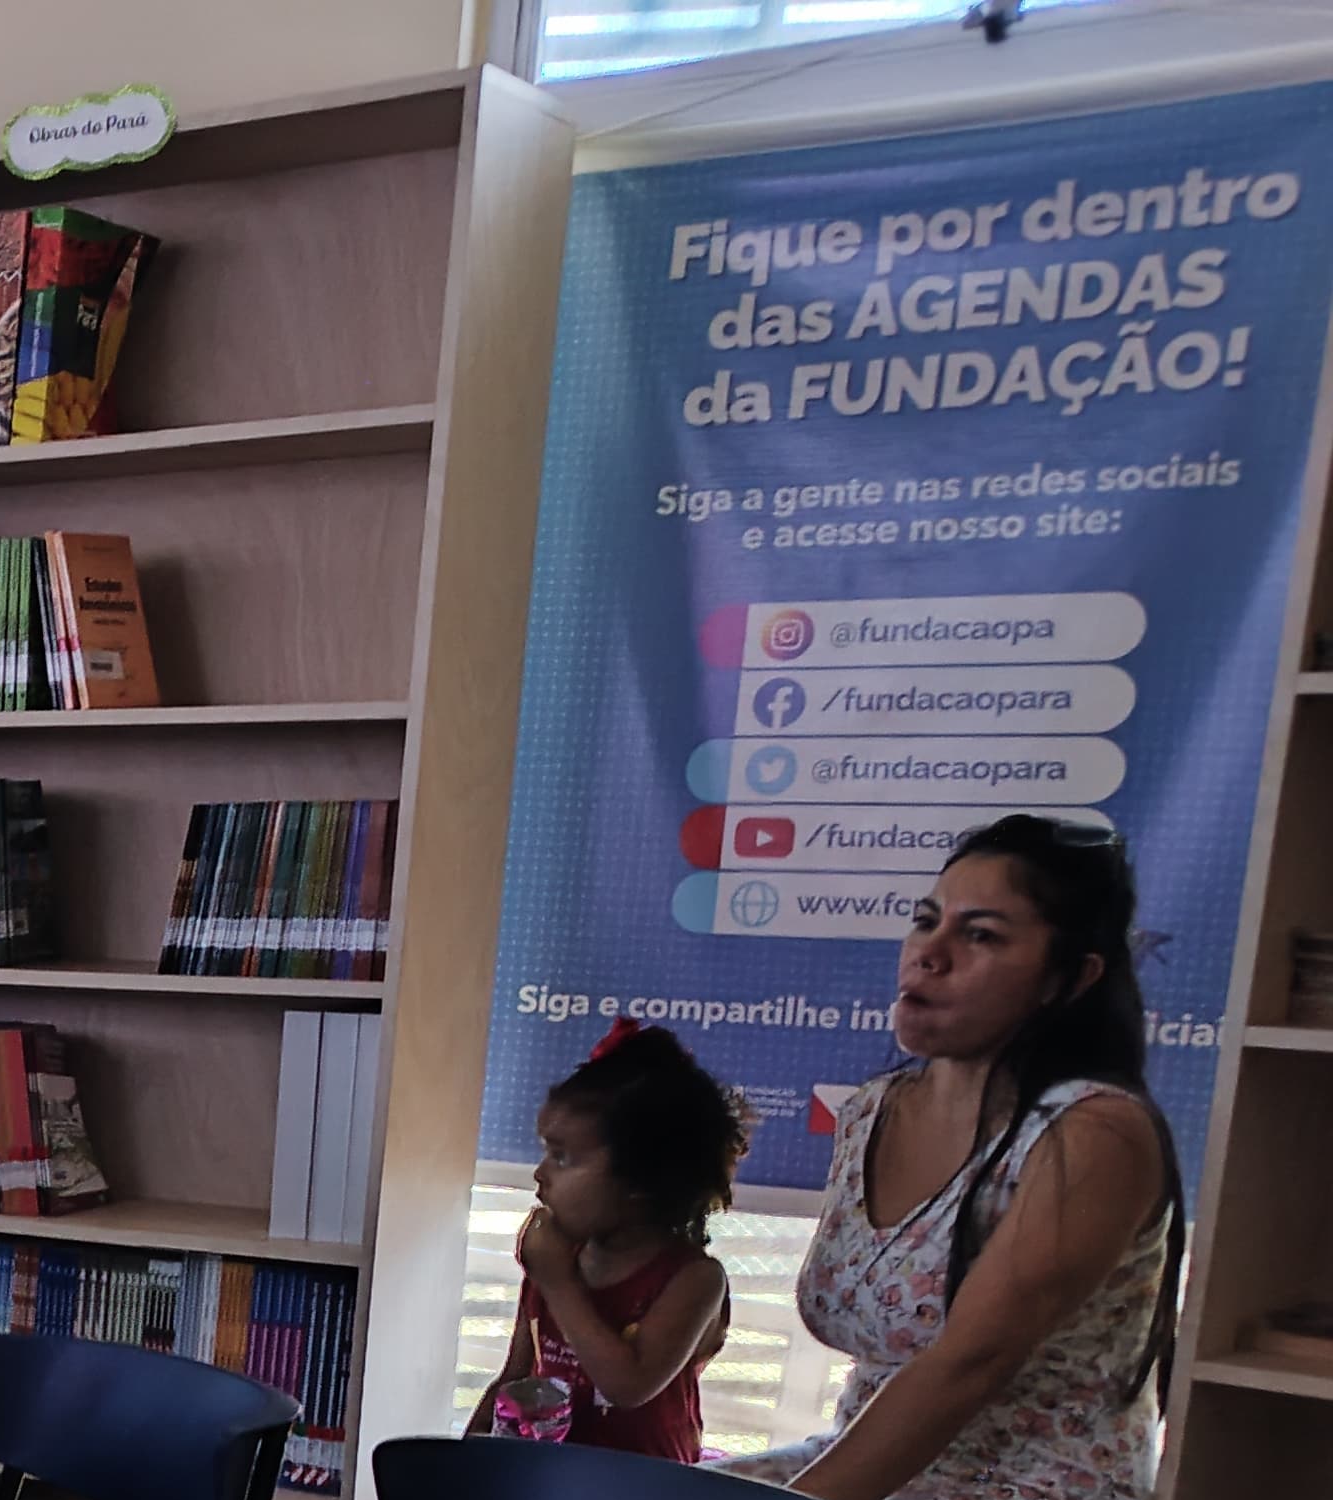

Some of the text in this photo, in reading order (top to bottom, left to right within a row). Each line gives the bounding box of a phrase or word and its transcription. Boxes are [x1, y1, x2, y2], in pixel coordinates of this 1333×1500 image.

[29, 111, 149, 144] Obras do Pará
[669, 167, 1300, 287] Fique por dentro
[708, 247, 1228, 351] das AGENDAS
[683, 319, 1251, 427] da FUNDAÇÃO!
[655, 450, 1241, 522] Siga a gente nas redes sociais
[741, 502, 1123, 549] e acesse nosso site:
[829, 616, 1056, 649] @fundacaopa
[821, 685, 1073, 717] /fundacaopara
[811, 754, 1068, 786] @fundacaopara
[516, 983, 590, 1023] Siga
[597, 994, 620, 1017] e
[627, 993, 841, 1031] compartilhe
